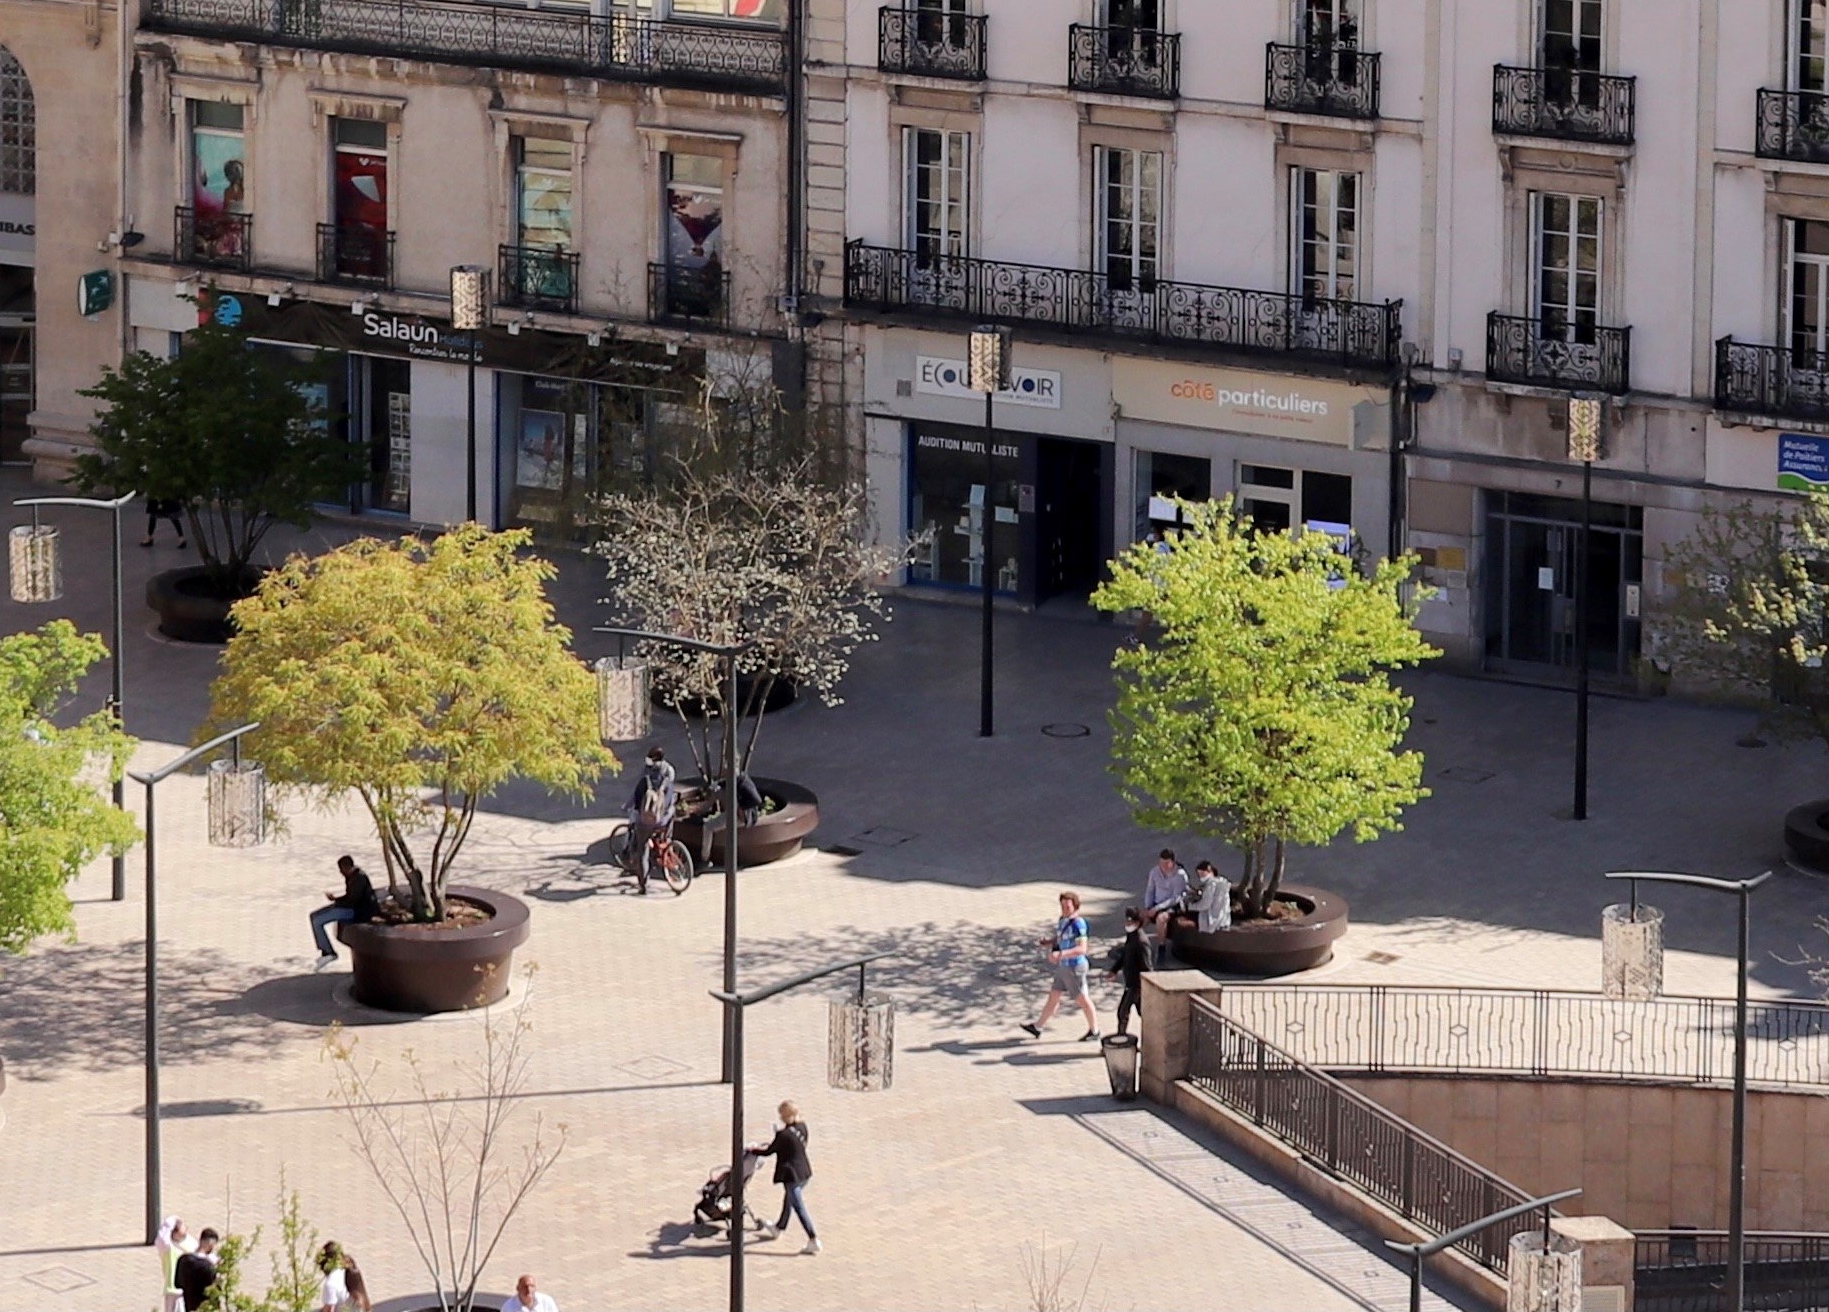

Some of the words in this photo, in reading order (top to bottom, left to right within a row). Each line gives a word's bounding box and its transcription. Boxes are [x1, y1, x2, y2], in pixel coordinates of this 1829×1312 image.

[1171, 380, 1214, 401] côté
[1218, 389, 1328, 415] particuliers
[918, 435, 960, 451] AUDITION
